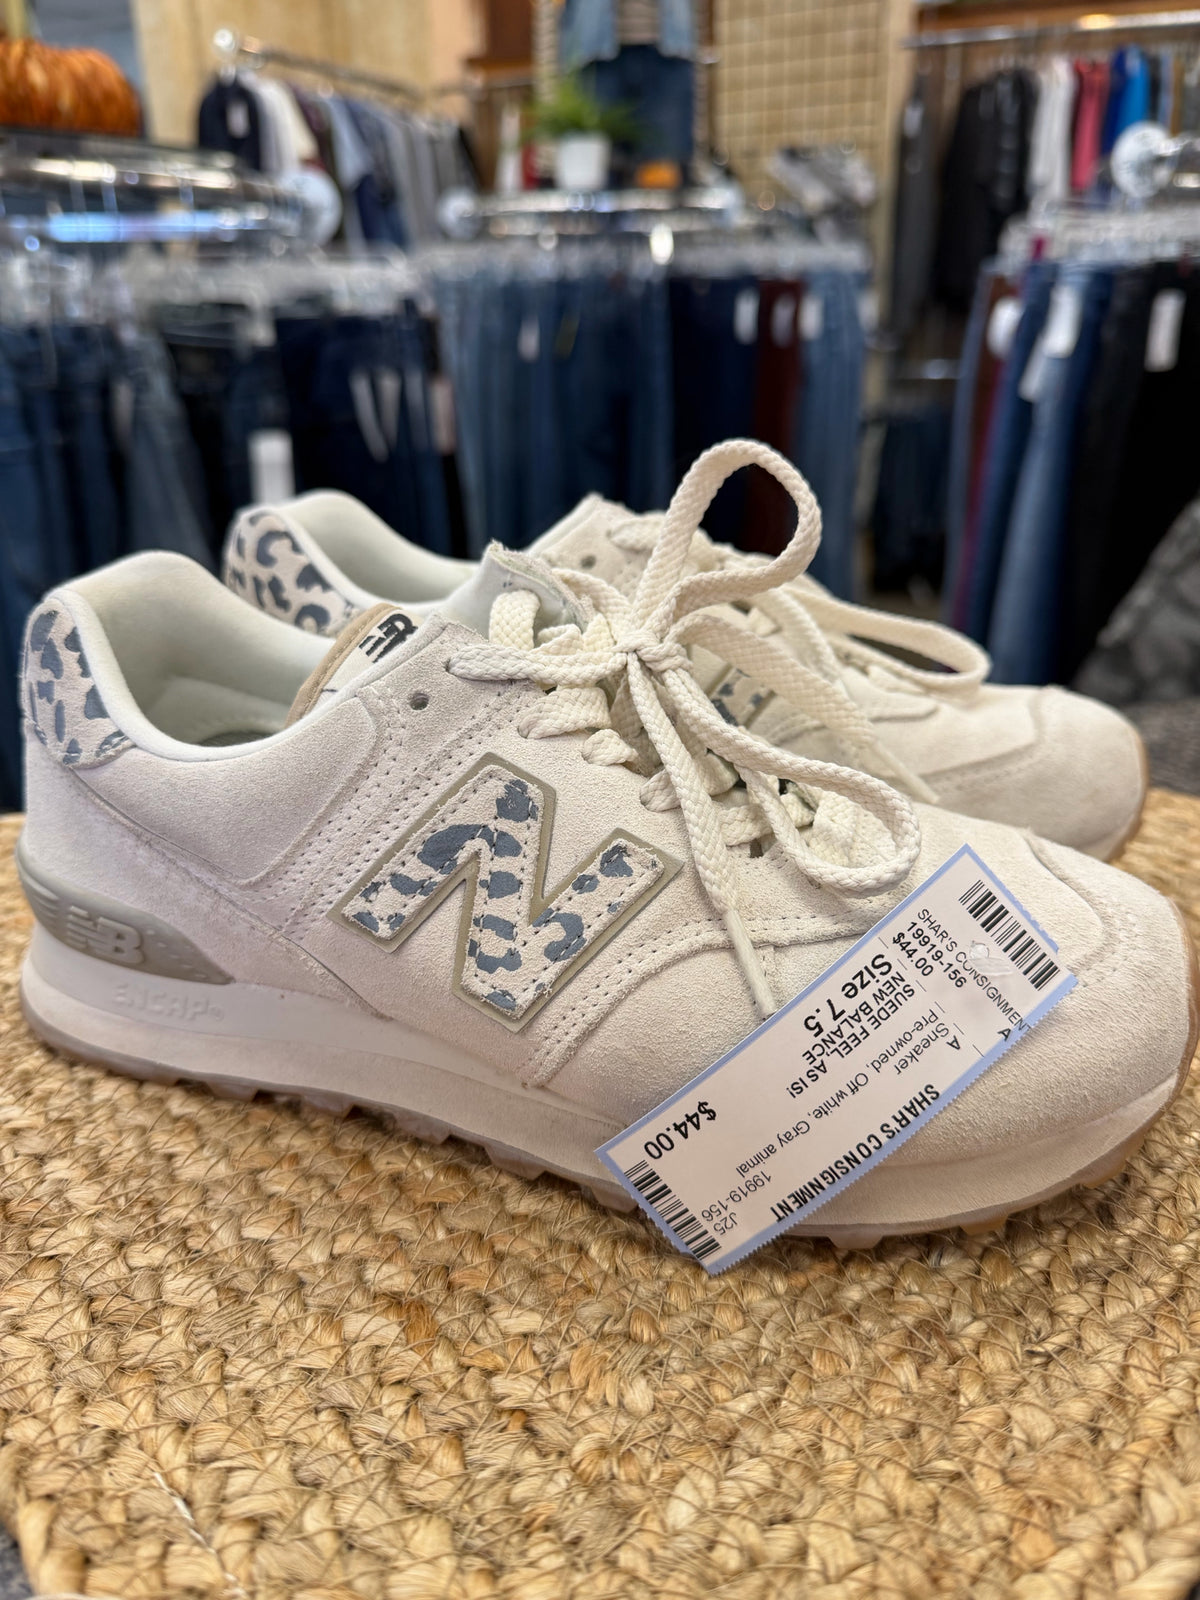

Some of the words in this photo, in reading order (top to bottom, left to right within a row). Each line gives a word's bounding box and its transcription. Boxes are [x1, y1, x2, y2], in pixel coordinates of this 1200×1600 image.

[917, 908, 957, 951] SHAR'S
[892, 932, 934, 977] $44.00
[907, 921, 967, 988] 19919-156
[841, 954, 893, 999] Size
[872, 972, 906, 1006] NEW
[803, 998, 846, 1038] 7.5
[869, 984, 915, 1030] SUEDE
[802, 1002, 873, 1065] BALANCE
[826, 1025, 870, 1060] FEEL,
[866, 1009, 938, 1073] Pre-owned,
[894, 1022, 950, 1075] Sneaker
[946, 1035, 961, 1050] A
[997, 1028, 1011, 1041] A
[785, 1077, 809, 1099] IS!
[806, 1060, 828, 1083] AS
[846, 1072, 869, 1096] Off
[808, 1089, 849, 1119] white,
[880, 1084, 940, 1140] SHAR'S
[643, 1101, 717, 1160] $44.00
[776, 1120, 811, 1148] Gray
[736, 1144, 777, 1178] animal
[770, 1133, 883, 1223] CONSIGNMENT
[701, 1170, 772, 1222] 19919-156
[713, 1212, 738, 1236] J25
